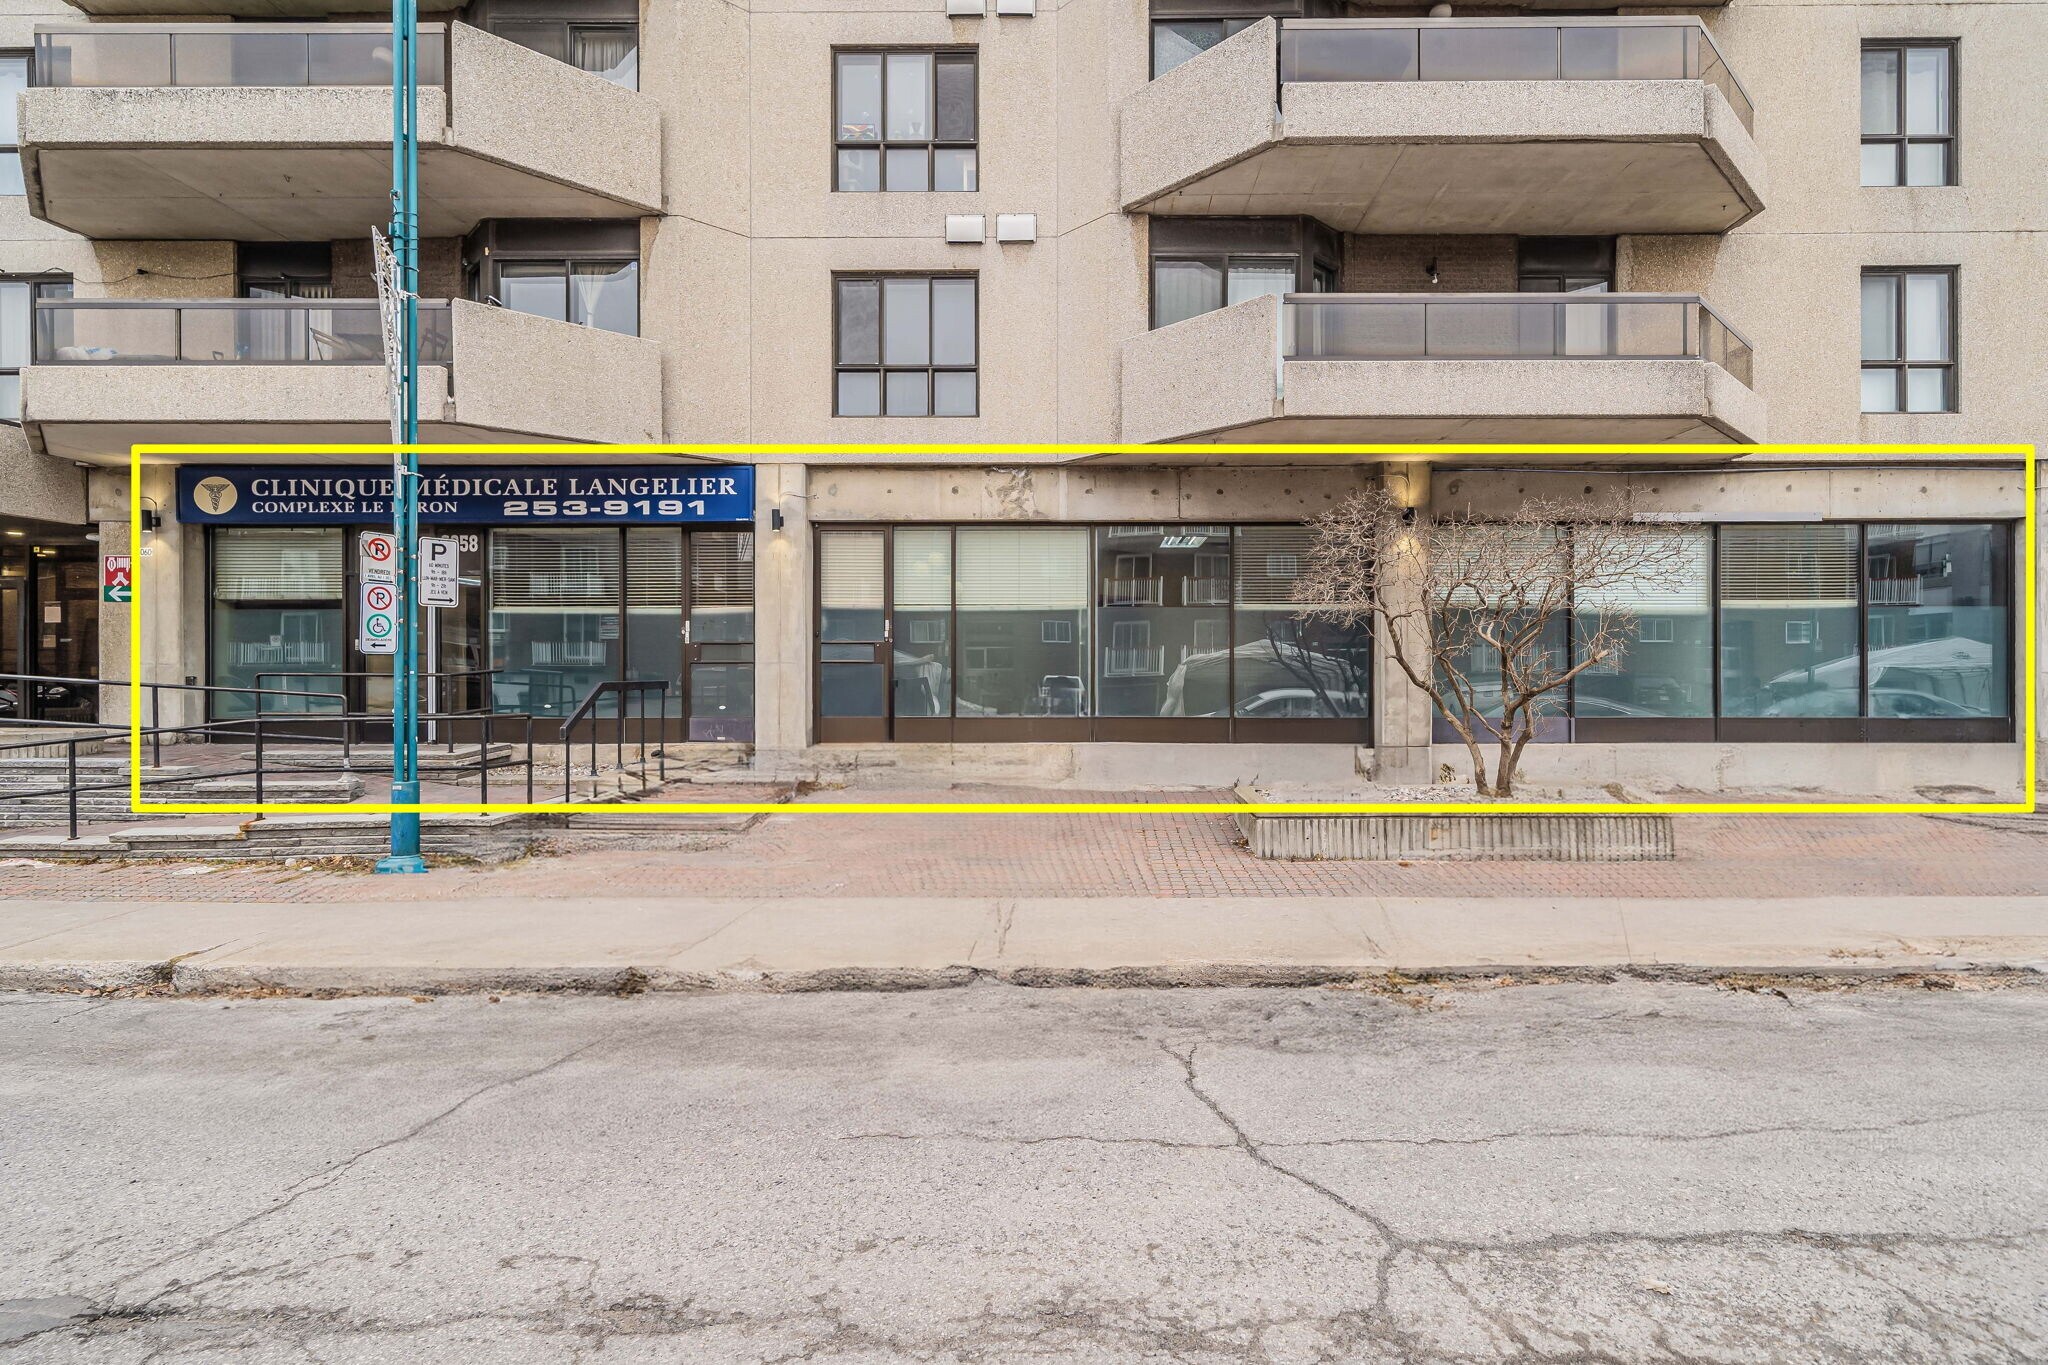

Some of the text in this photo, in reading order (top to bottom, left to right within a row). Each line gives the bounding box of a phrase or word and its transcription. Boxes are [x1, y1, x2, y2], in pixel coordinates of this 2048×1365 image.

[251, 478, 394, 500] CLINIQUE
[568, 477, 738, 496] LANGELIER
[252, 501, 458, 513] COMPLEXE LE RON
[503, 500, 705, 516] 253-9191
[441, 534, 479, 552] 58
